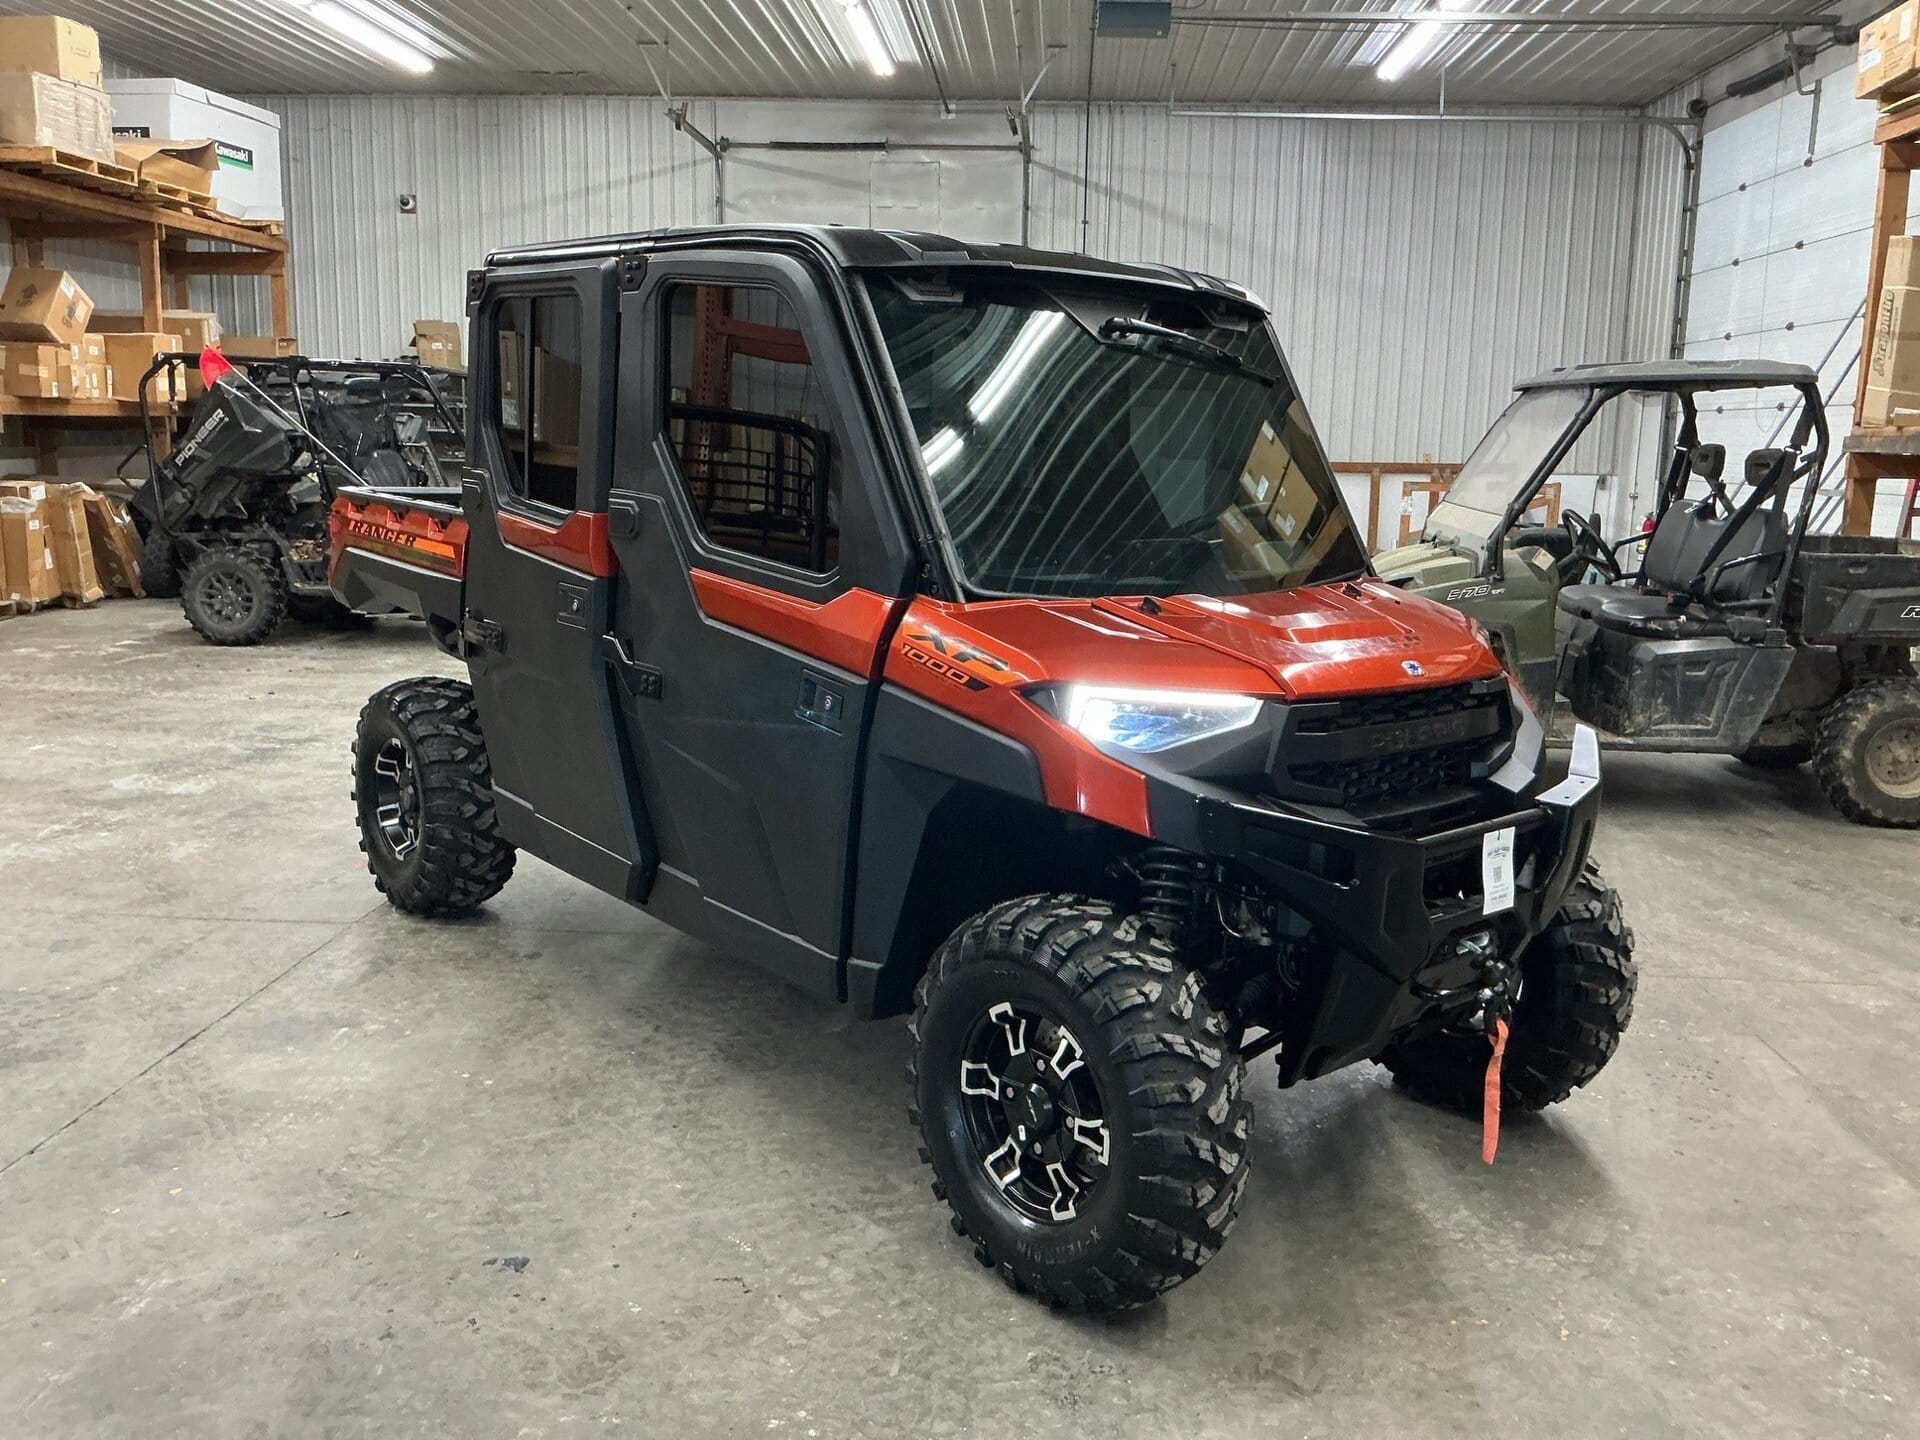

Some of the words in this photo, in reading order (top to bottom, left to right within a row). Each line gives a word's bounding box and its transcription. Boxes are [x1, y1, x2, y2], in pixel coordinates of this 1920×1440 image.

[175, 408, 224, 467] PIONEER
[352, 521, 417, 548] RANGER
[901, 644, 970, 684] 1000
[904, 624, 1010, 672] XP
